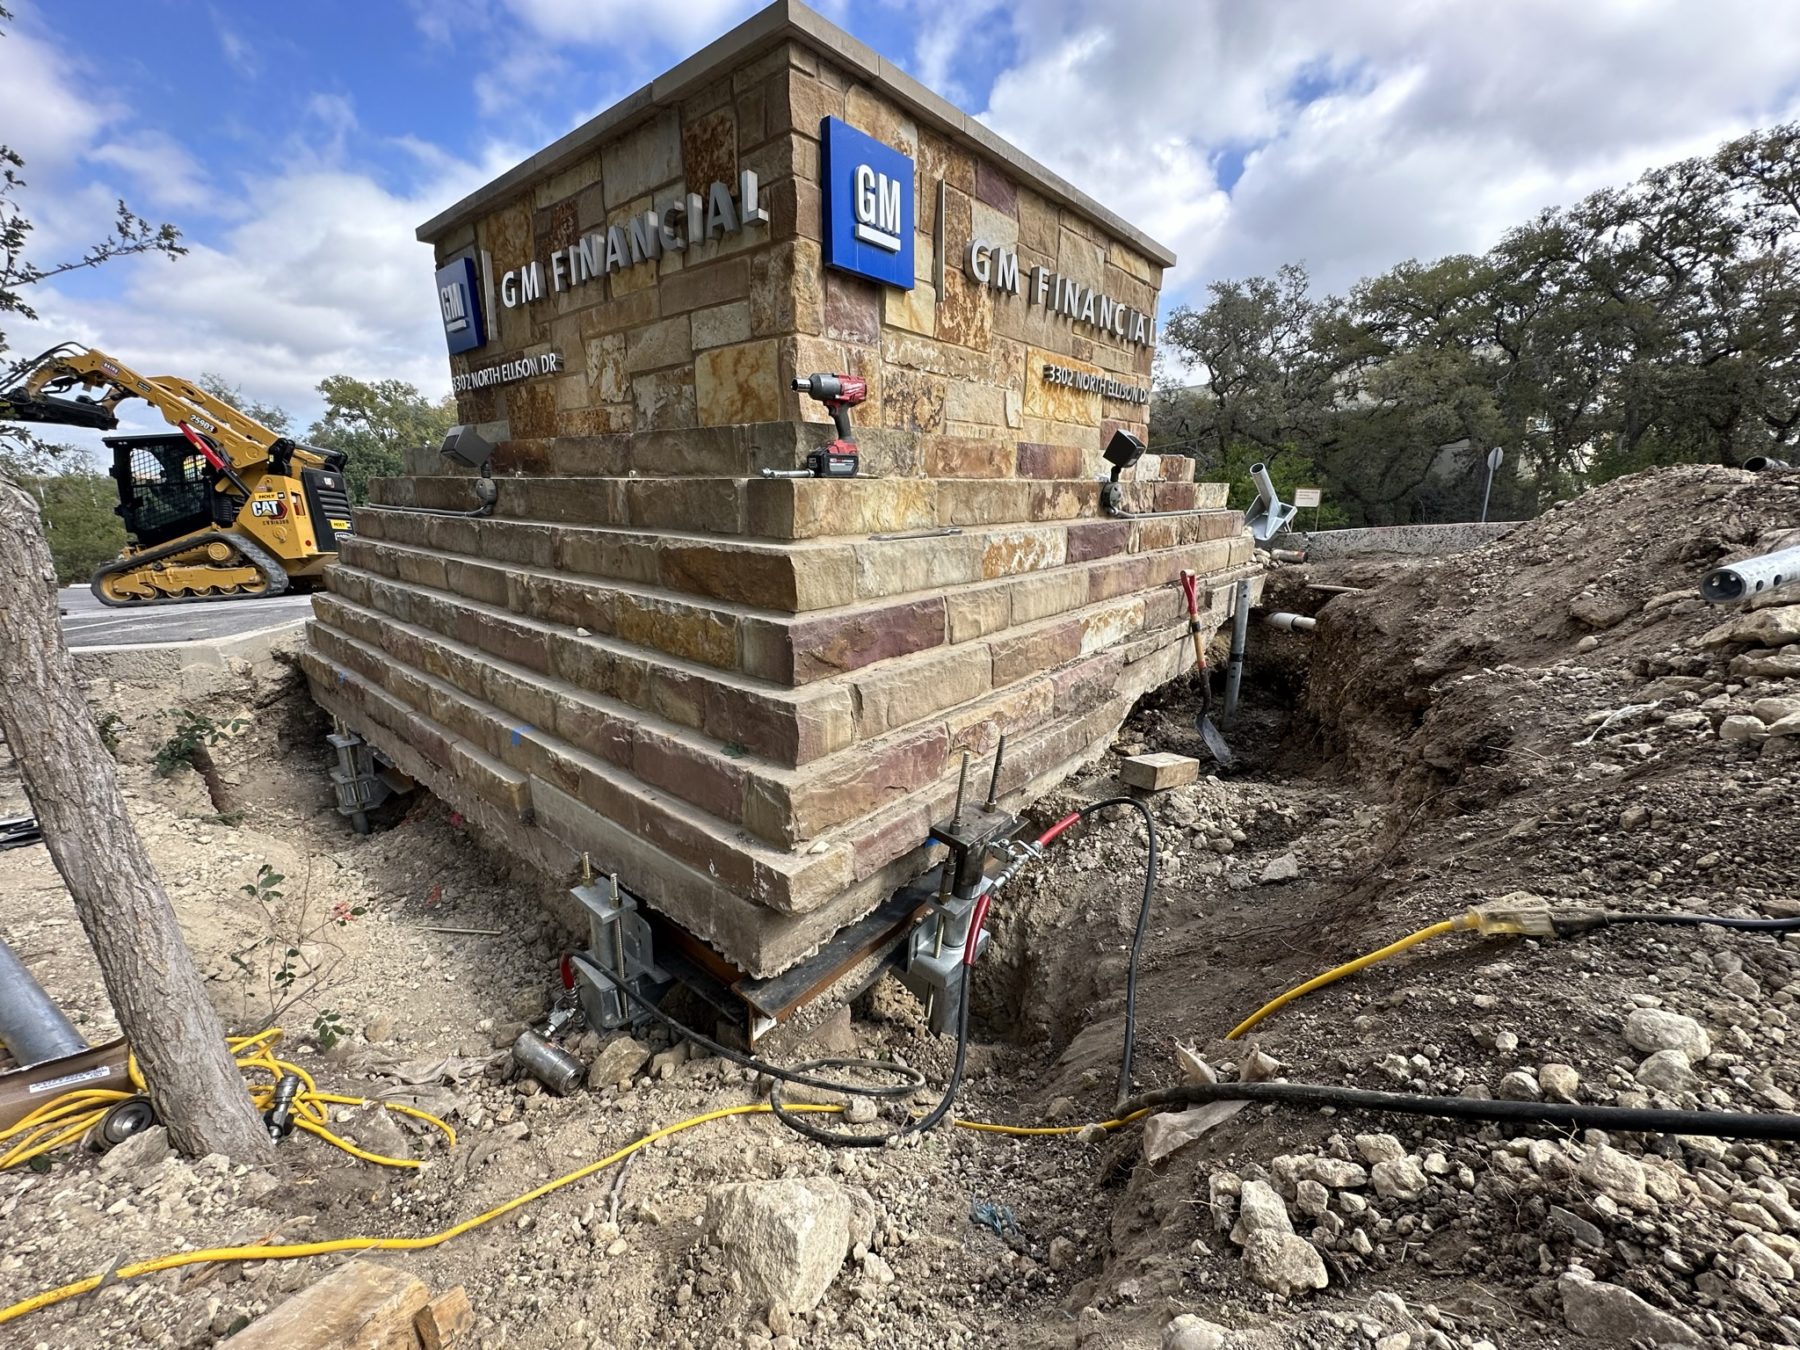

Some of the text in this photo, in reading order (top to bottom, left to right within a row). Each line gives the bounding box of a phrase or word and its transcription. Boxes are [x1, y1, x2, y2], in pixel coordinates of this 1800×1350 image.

[854, 164, 901, 235] GM
[502, 169, 769, 308] GM FINANCIAL
[440, 282, 466, 322] GM
[967, 239, 1157, 347] GM FINANCIAL
[452, 352, 558, 392] 3302 NORTH ELLISON DR
[1048, 364, 1074, 387] 3302
[1075, 372, 1106, 395] NORTH
[1108, 379, 1139, 402] ELLISON
[251, 500, 279, 517] CAT
